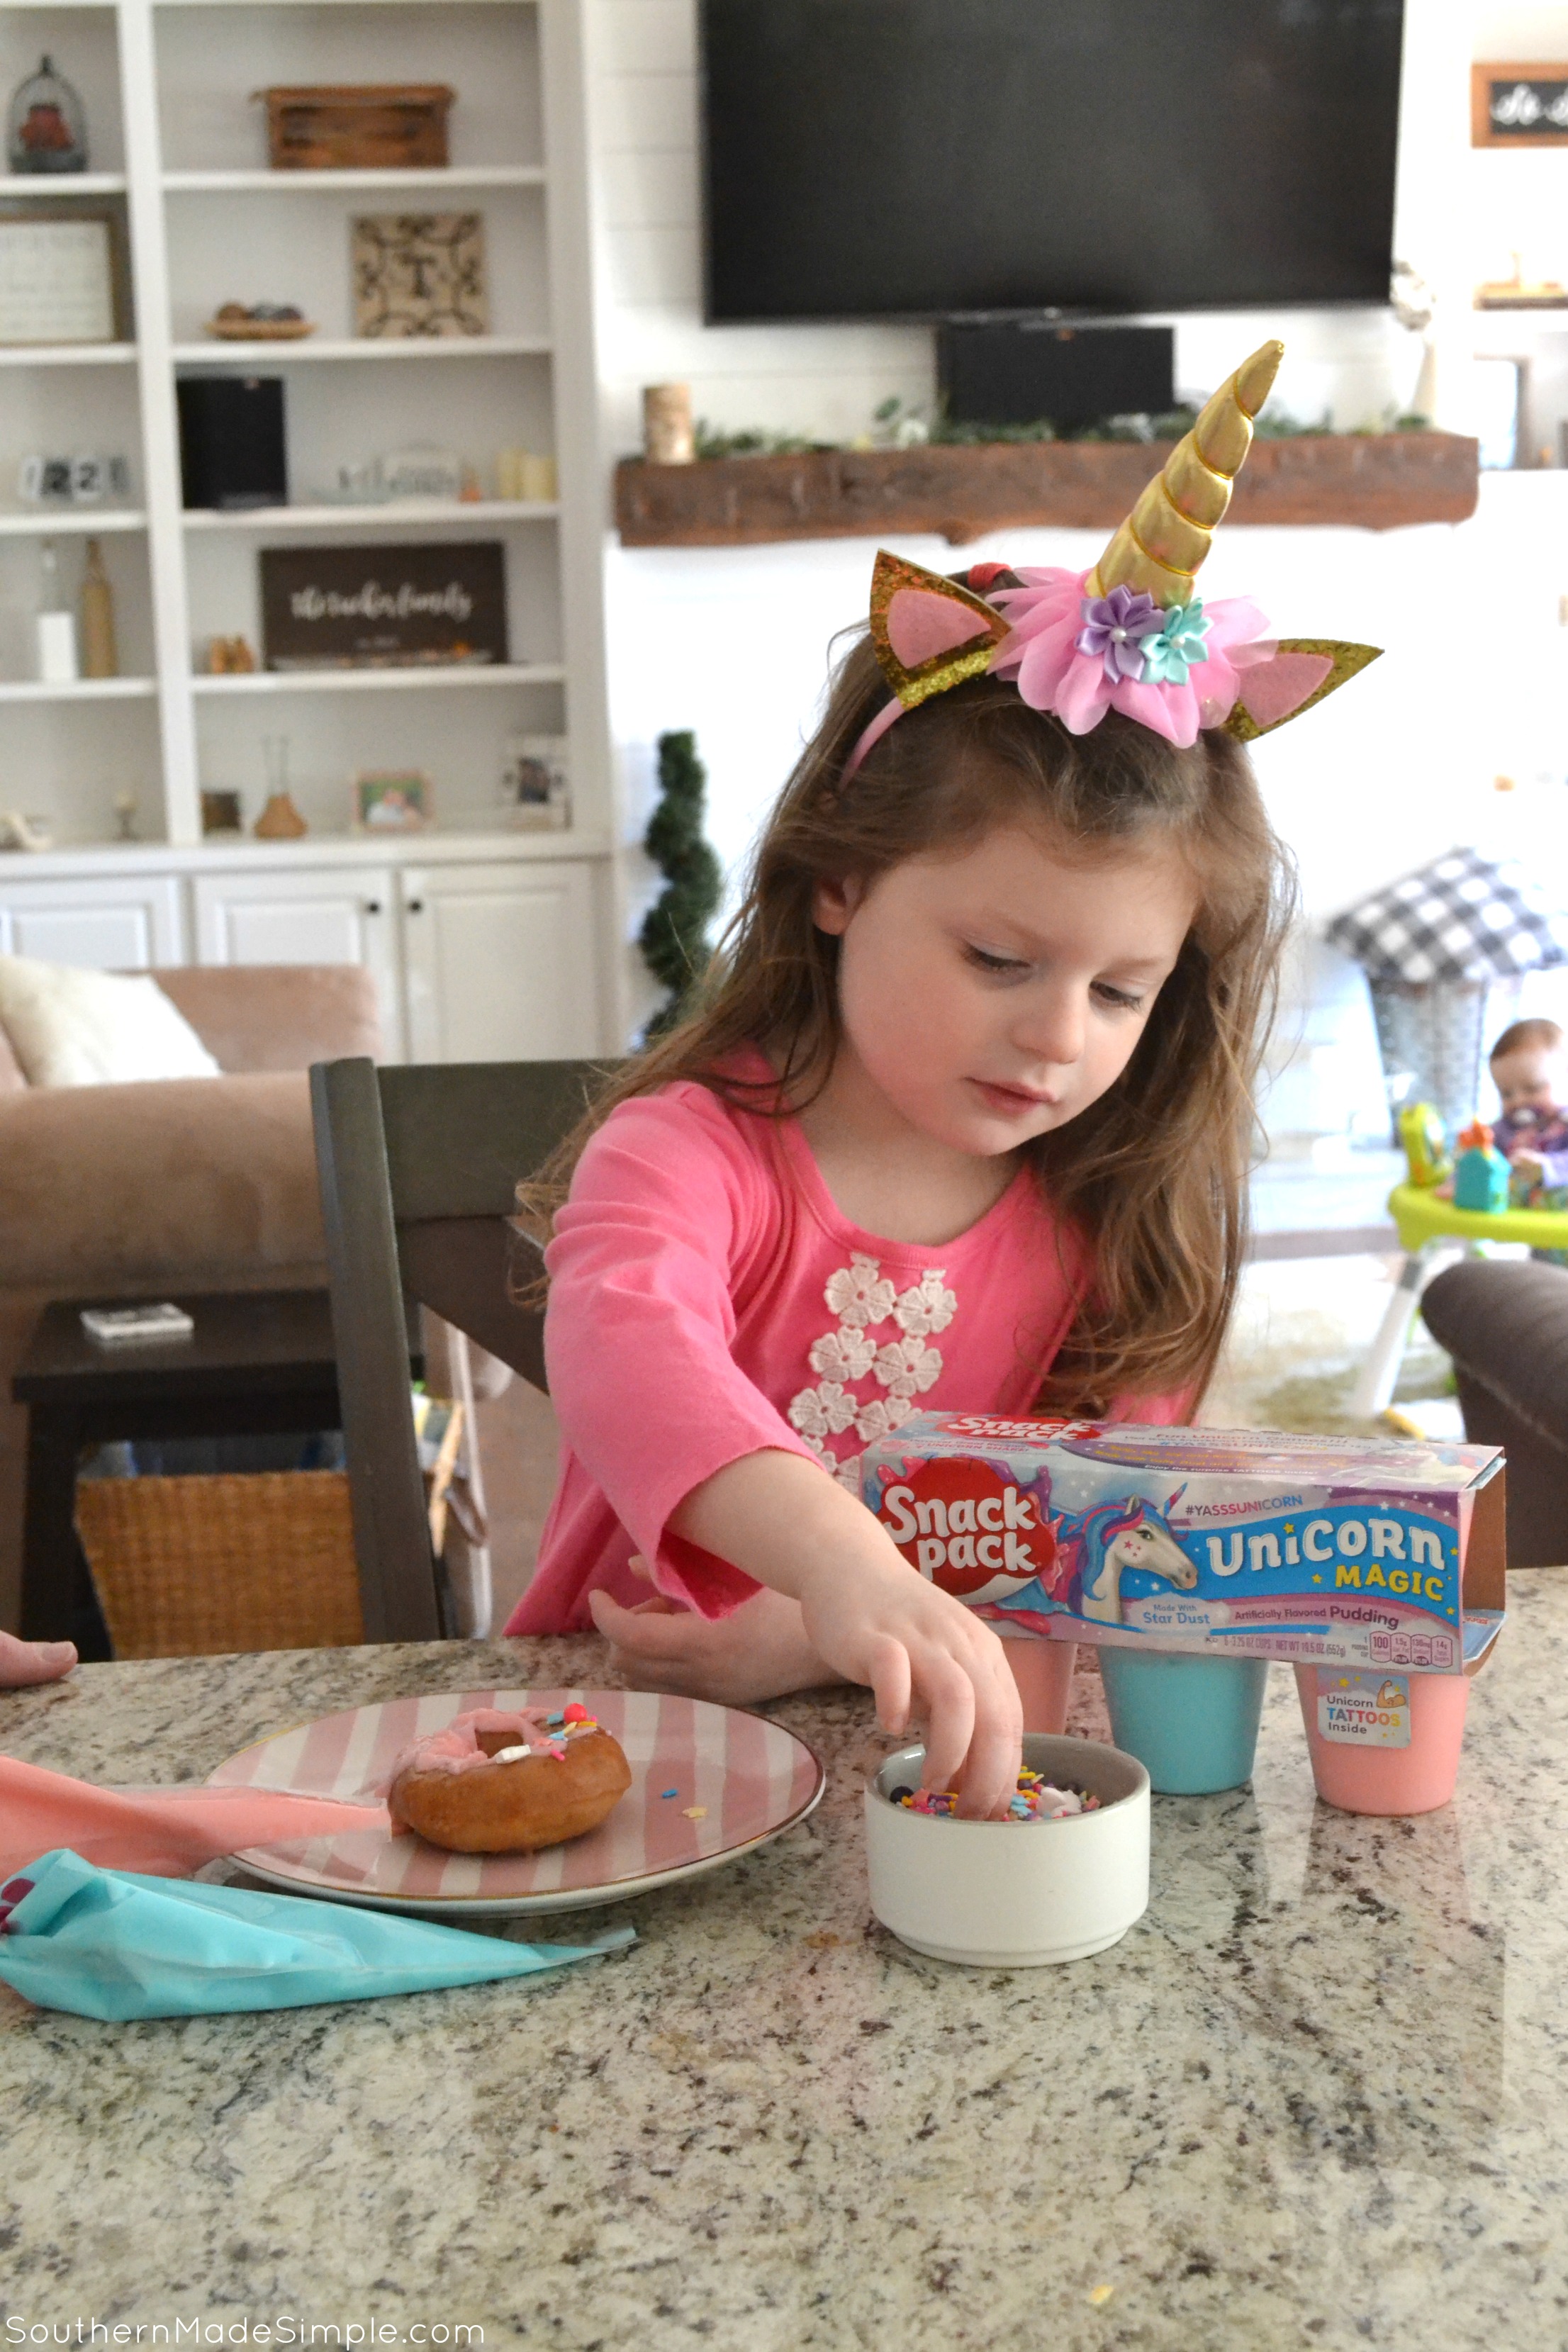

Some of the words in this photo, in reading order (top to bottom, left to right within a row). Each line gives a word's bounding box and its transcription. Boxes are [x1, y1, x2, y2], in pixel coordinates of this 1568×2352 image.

[948, 1417, 1092, 1432] Snack
[883, 1486, 1036, 1544] Snack
[1185, 1495, 1303, 1517] #YASSSUNICORN
[917, 1532, 1036, 1581] pack
[1335, 1564, 1444, 1601] MAGIC
[1153, 1604, 1176, 1613] Made
[1143, 1613, 1172, 1624] Star
[1177, 1613, 1211, 1624] Dust
[1235, 1608, 1282, 1620] Artificially
[1284, 1606, 1326, 1618] Flavored
[1330, 1606, 1399, 1630] Pudding
[1275, 1640, 1288, 1650] NET
[1288, 1641, 1299, 1651] WT
[1326, 1645, 1346, 1658] (552g)
[1373, 1636, 1389, 1649] 100
[1327, 1695, 1373, 1708] Unicorn
[1326, 1707, 1401, 1727] TATTOOS
[1328, 1722, 1367, 1734] Inside
